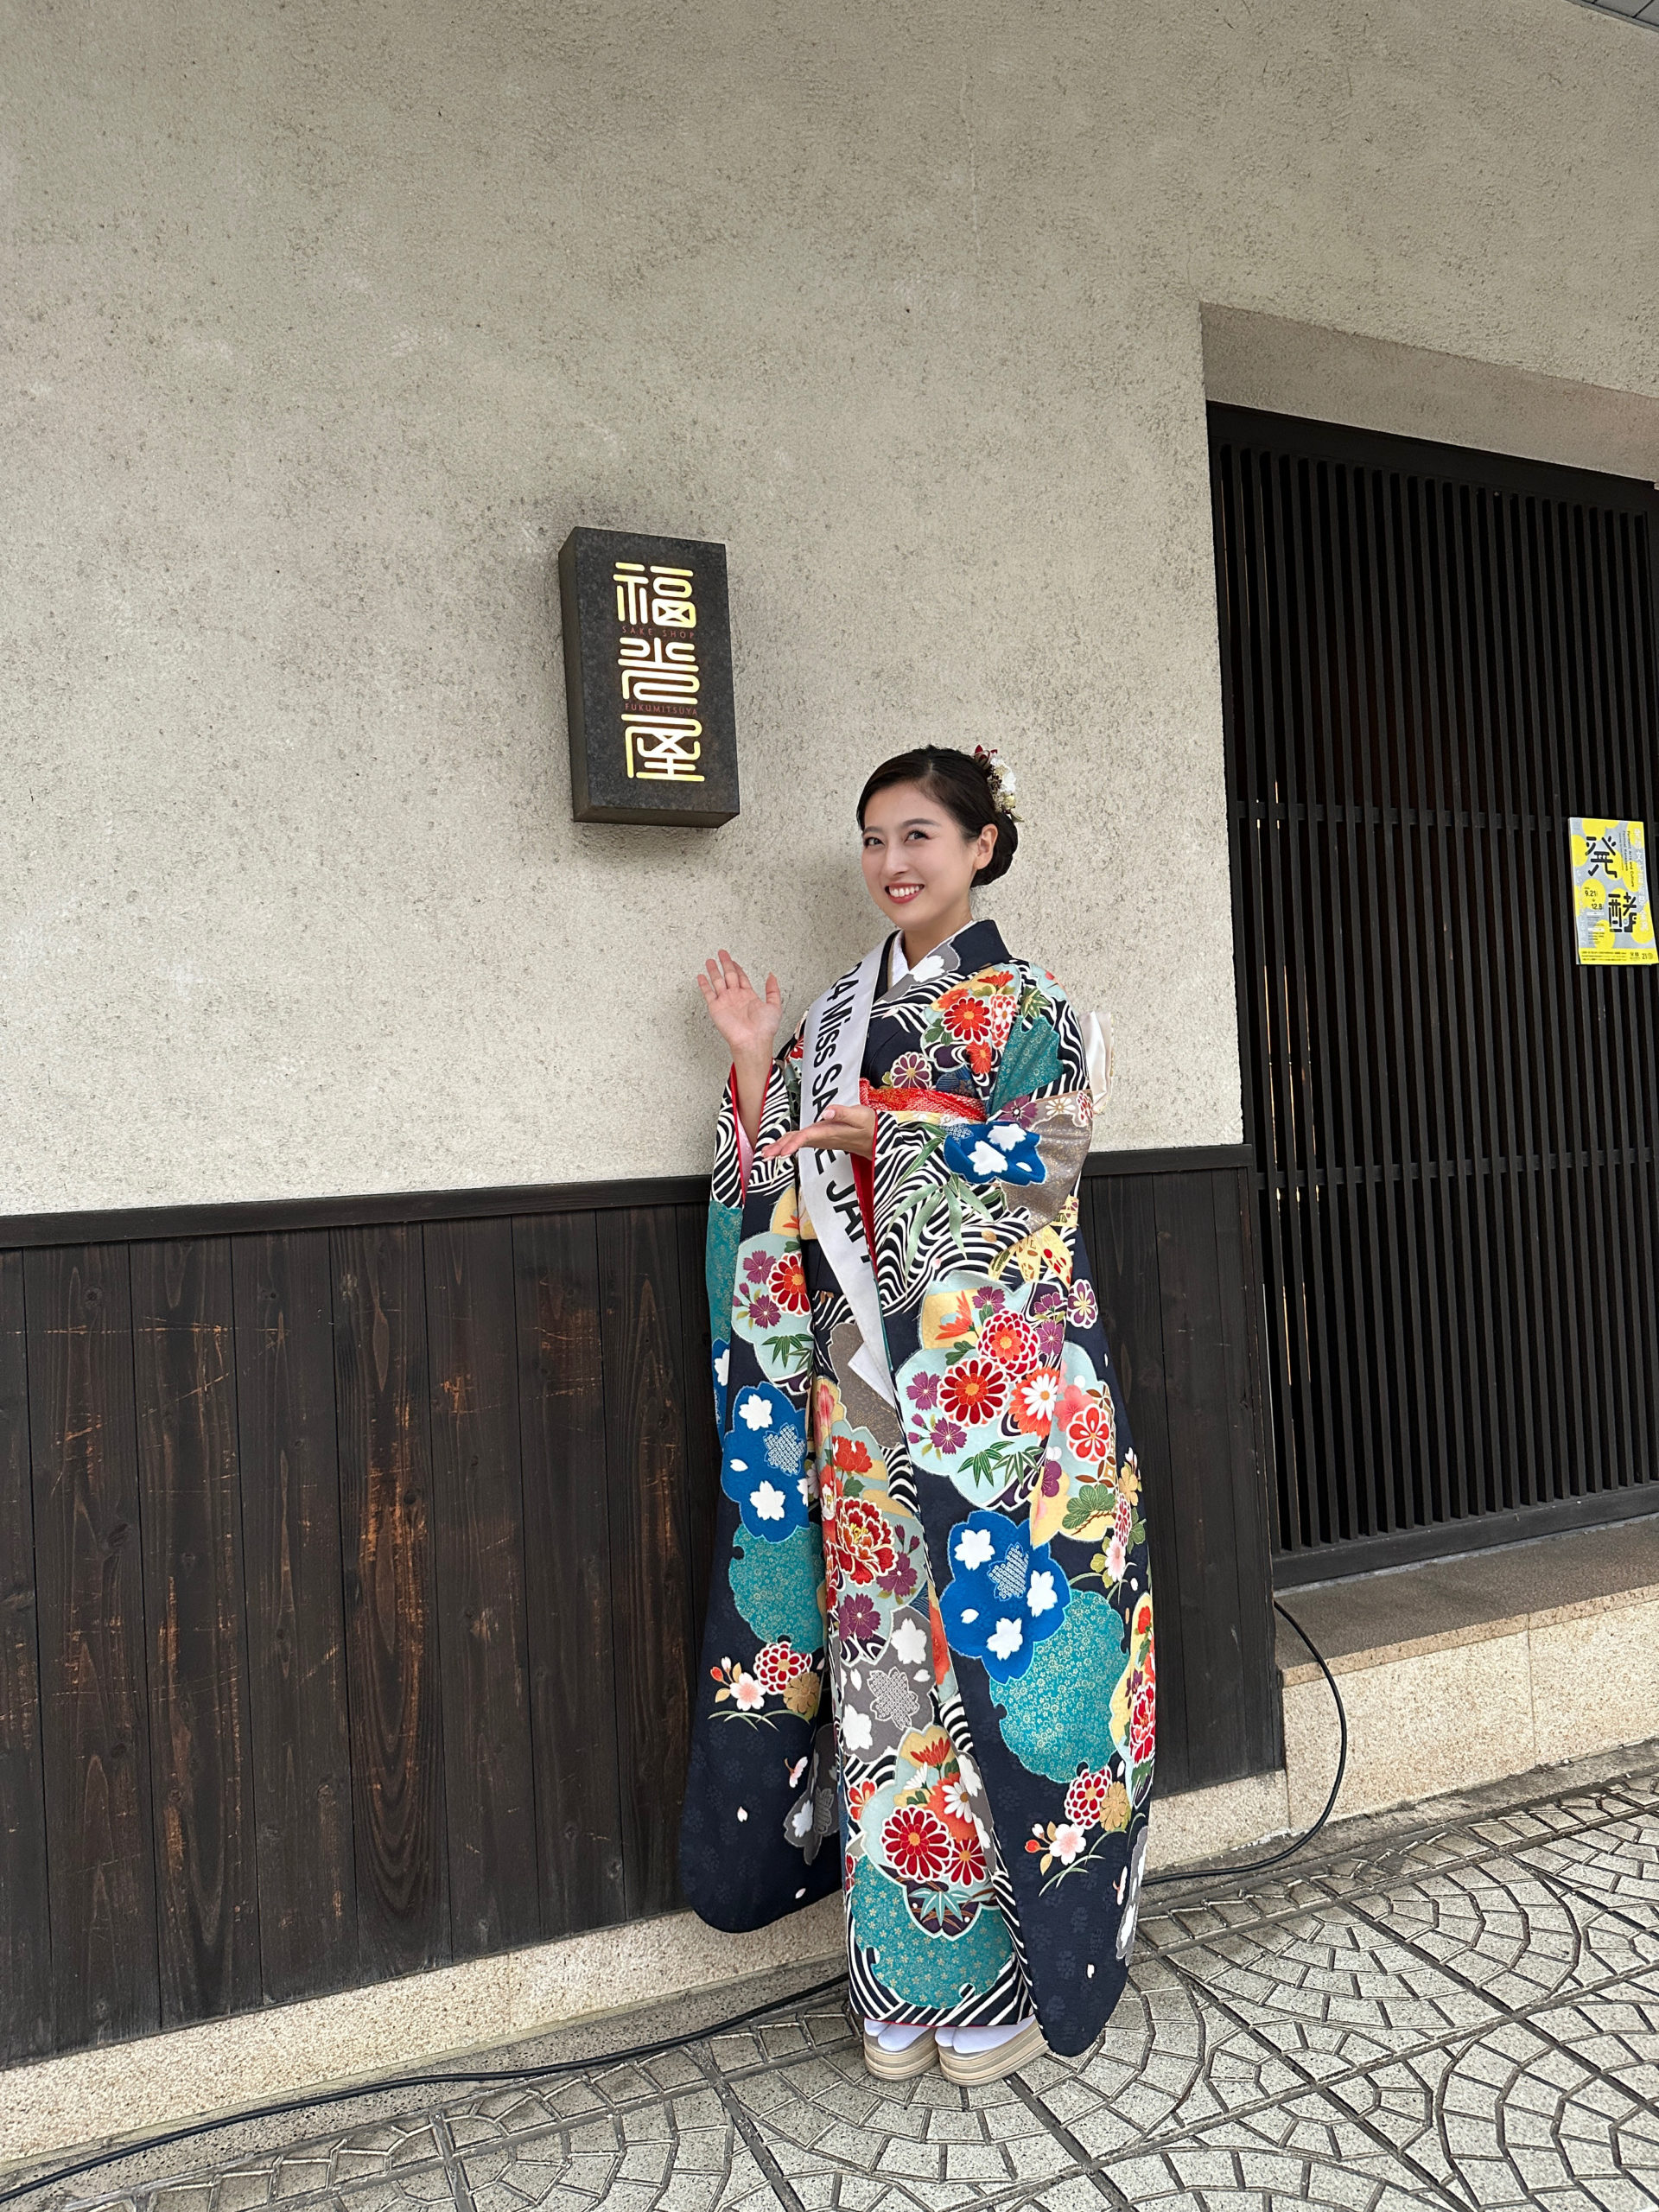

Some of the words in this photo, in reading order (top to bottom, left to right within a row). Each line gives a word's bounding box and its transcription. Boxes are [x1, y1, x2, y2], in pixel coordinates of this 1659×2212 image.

[613, 562, 705, 782] 福光屋
[621, 625, 653, 636] SAKE
[662, 629, 696, 639] SHOP
[624, 702, 698, 716] FUKUMITSUYA
[812, 1063, 849, 1175] SAE
[826, 1179, 871, 1264] JA
